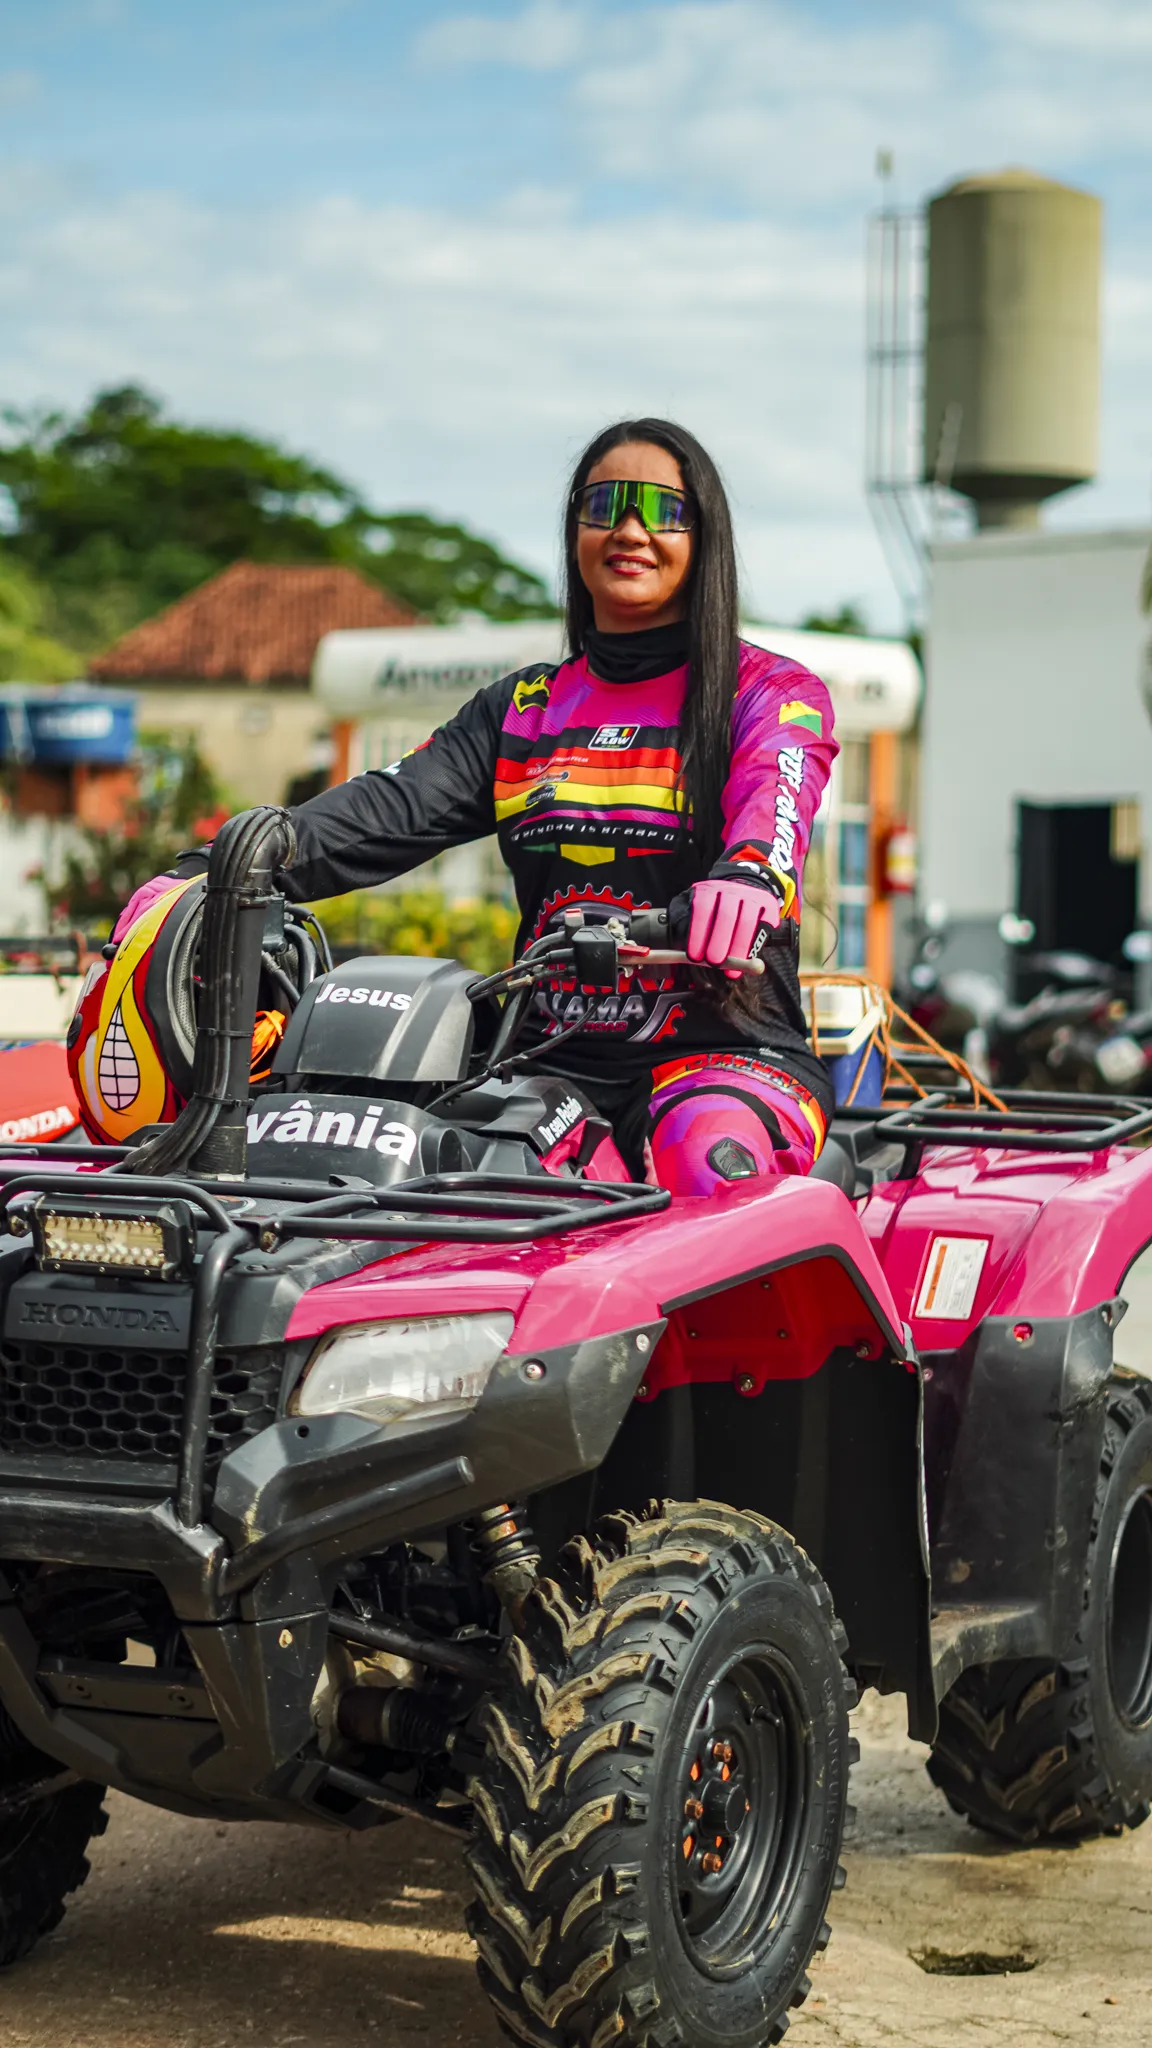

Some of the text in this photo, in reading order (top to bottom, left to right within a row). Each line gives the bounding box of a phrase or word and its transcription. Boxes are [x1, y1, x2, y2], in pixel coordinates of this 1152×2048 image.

[595, 737, 631, 745] FLOW
[315, 983, 413, 1011] Jesus
[0, 1105, 75, 1142] ONDA
[246, 1100, 418, 1166] vânia
[538, 1125, 557, 1146] Dr
[19, 1301, 180, 1333] HONDA
